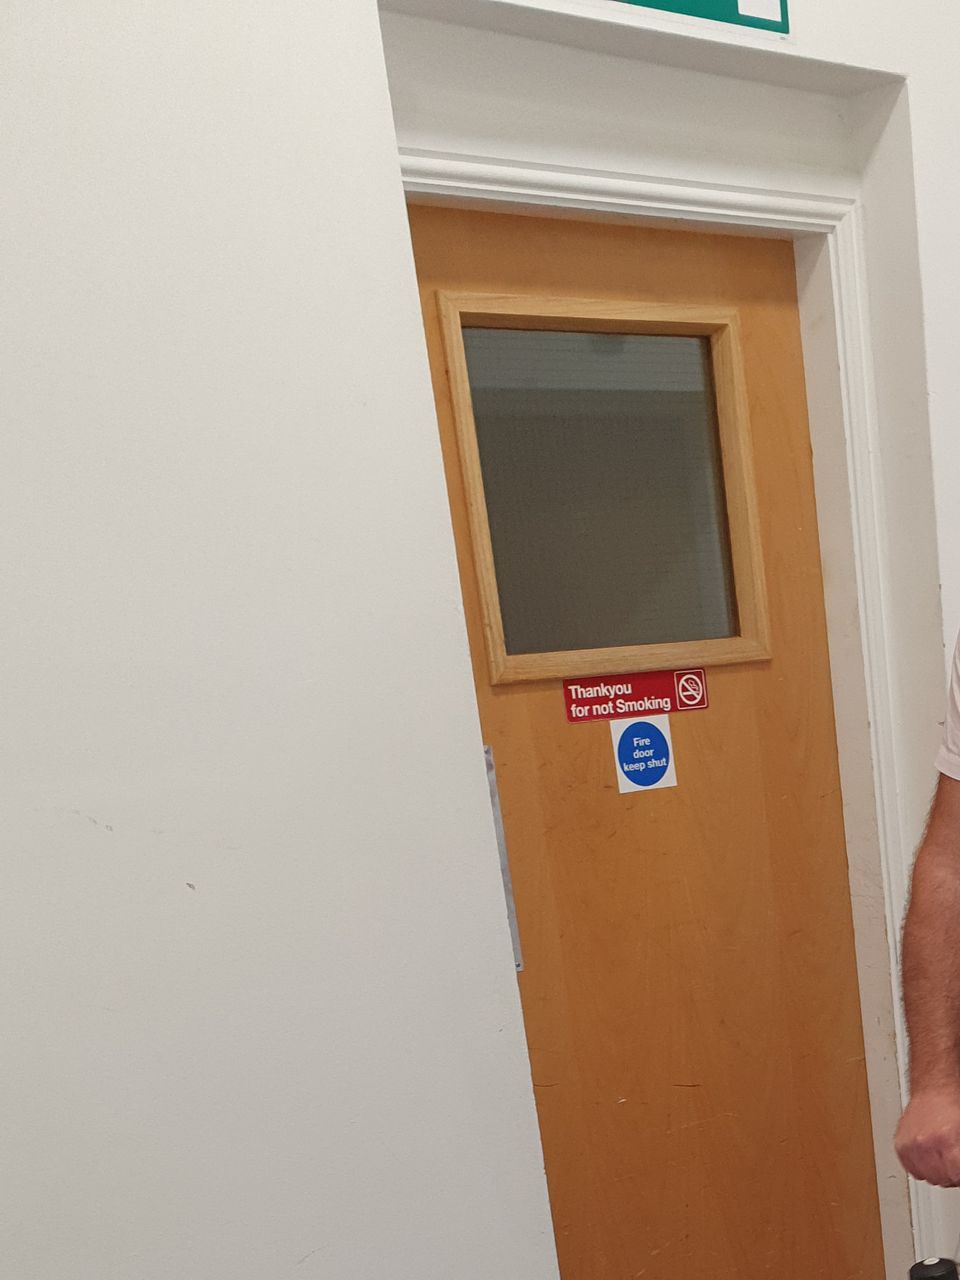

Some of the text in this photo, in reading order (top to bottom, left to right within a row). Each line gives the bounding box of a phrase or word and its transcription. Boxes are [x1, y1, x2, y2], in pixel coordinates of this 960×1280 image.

[568, 683, 632, 699] Thankyou
[571, 696, 671, 717] for not Smoking
[633, 737, 651, 747] Fire
[633, 749, 654, 759] door
[623, 757, 667, 772] keep shut
